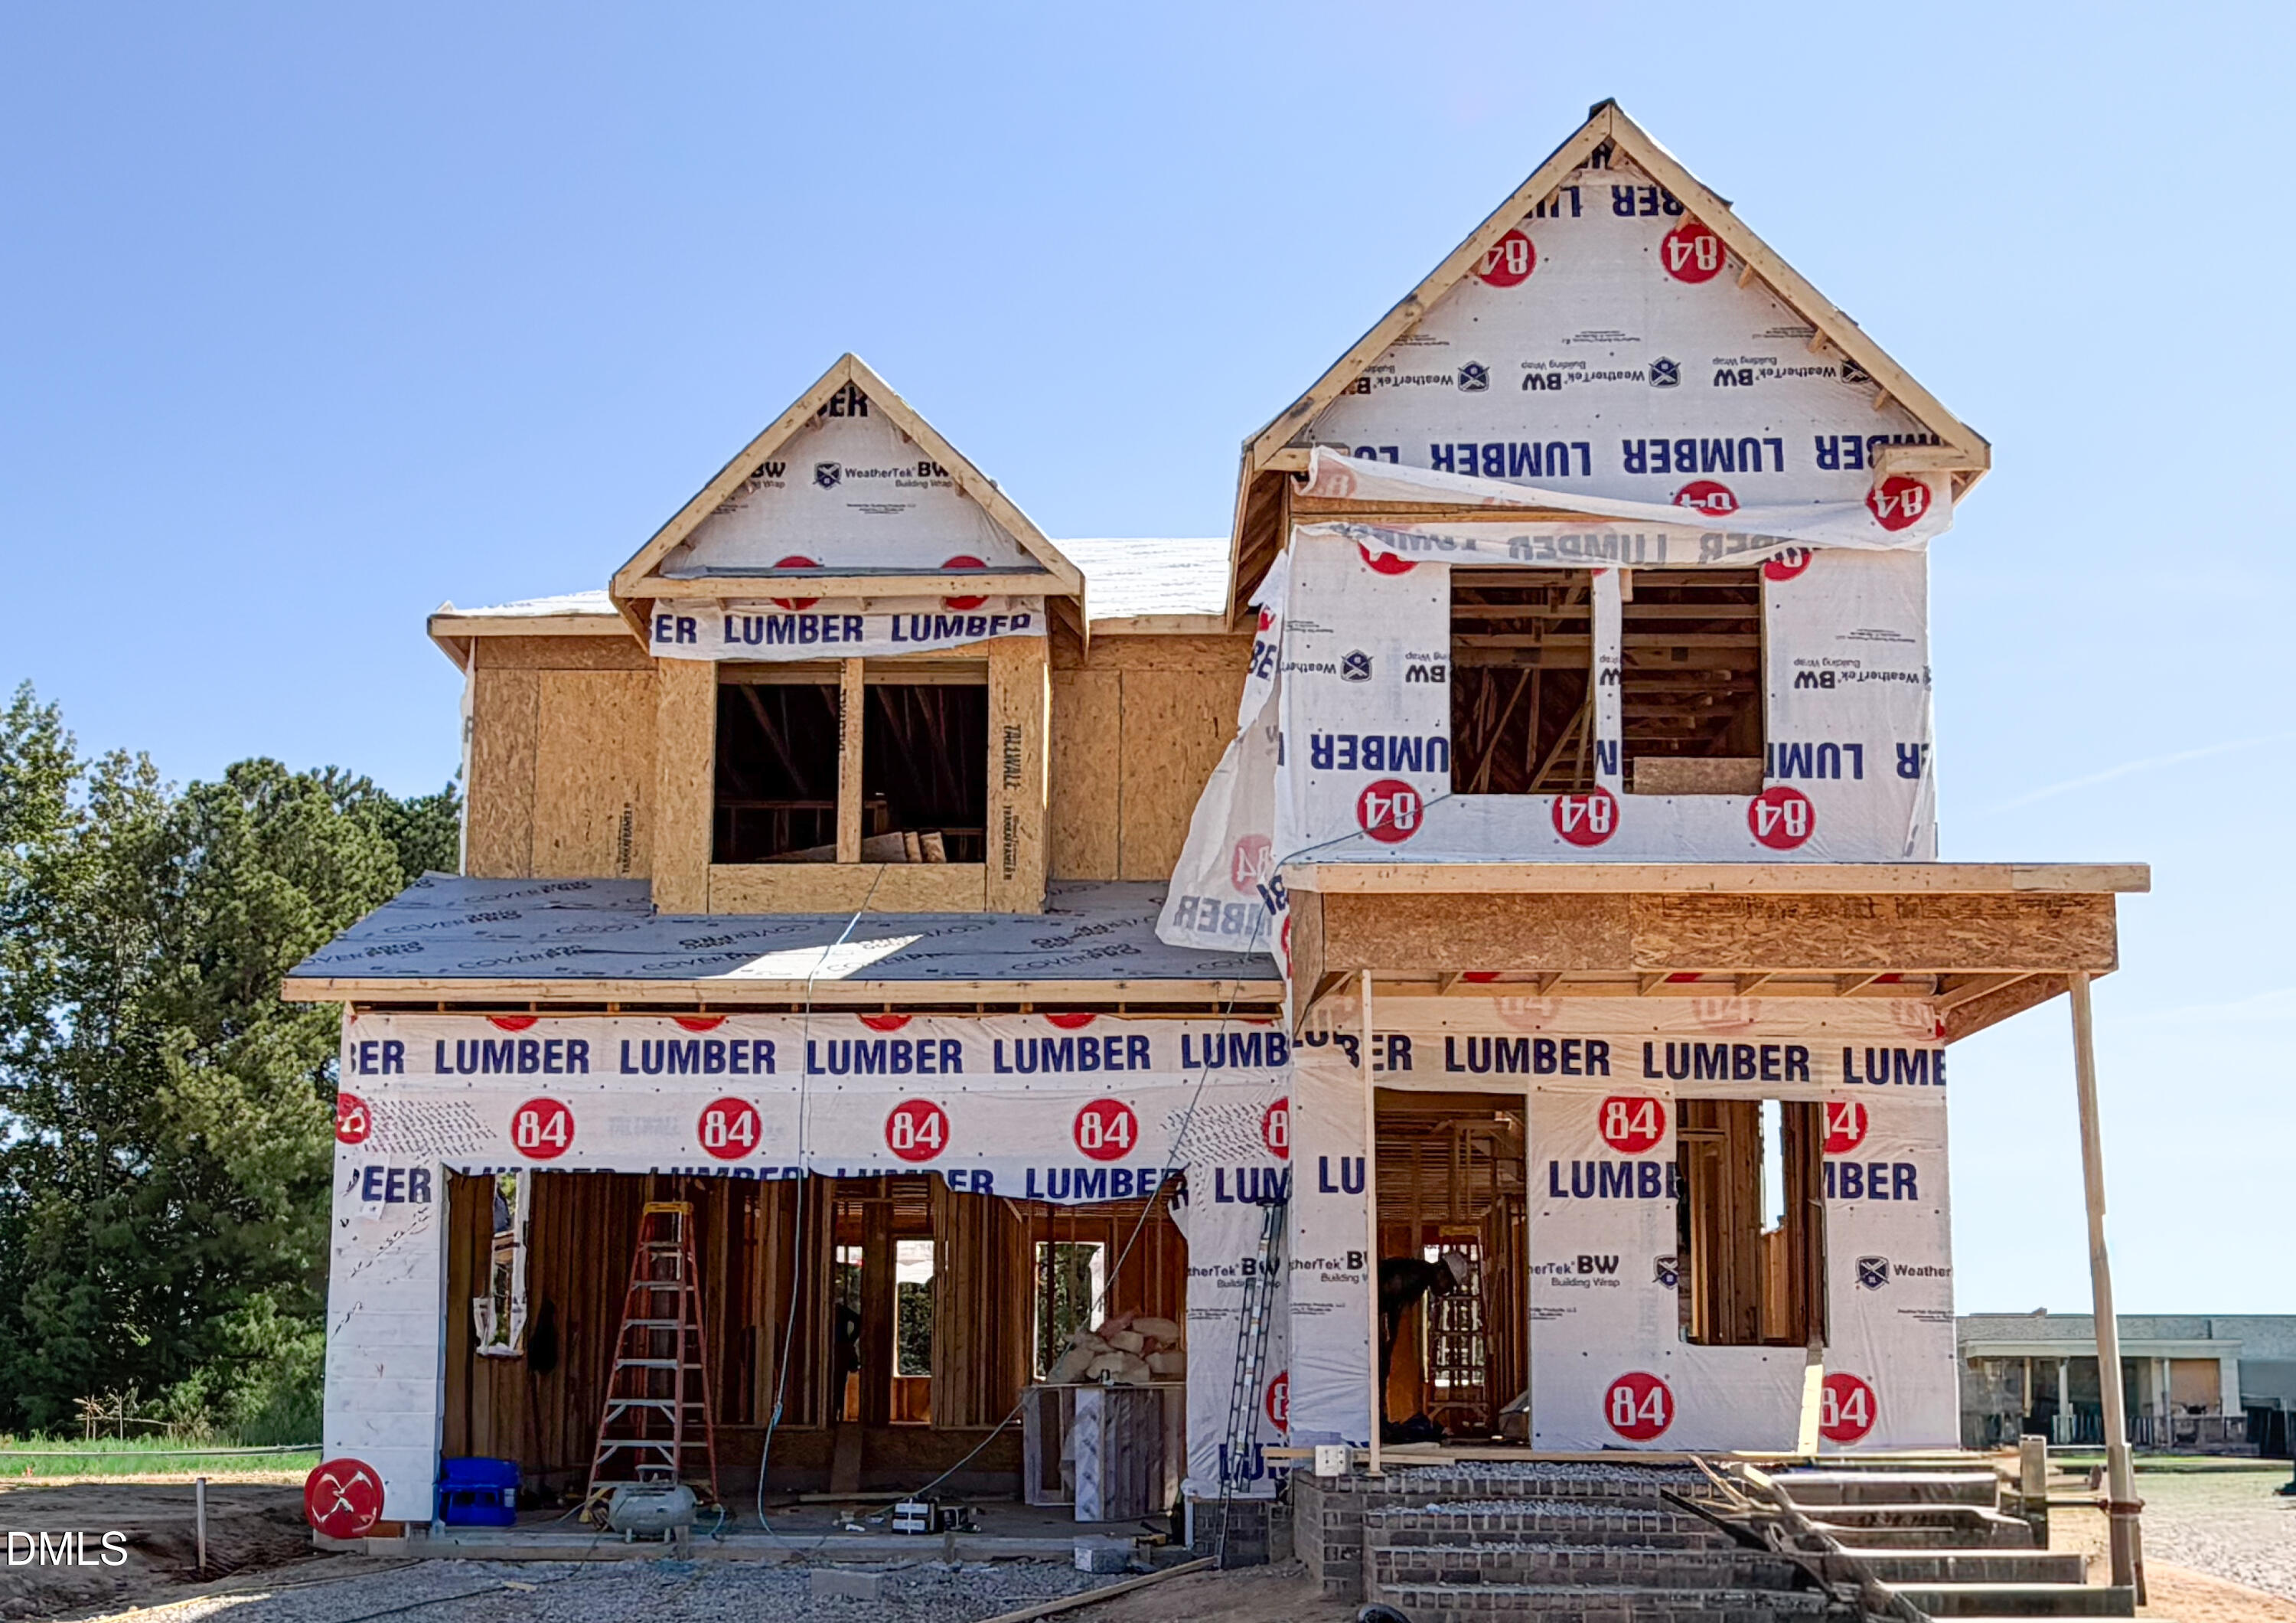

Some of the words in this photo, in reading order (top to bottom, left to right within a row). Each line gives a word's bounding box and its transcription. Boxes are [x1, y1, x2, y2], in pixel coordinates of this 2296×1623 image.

[1479, 239, 1528, 276] 84
[1668, 235, 1718, 272] 84
[1521, 372, 1562, 391] BW
[1713, 367, 1754, 387] BW
[844, 467, 916, 479] WeatherTek
[1430, 441, 1591, 478] LUMBER
[1622, 437, 1784, 474] LUMBER
[1872, 485, 1924, 519] 84
[649, 614, 697, 645] ER
[723, 613, 864, 645] LUMBER
[1404, 664, 1446, 684] BW
[1792, 671, 1836, 690] BW
[1767, 741, 1864, 780] LUM
[1364, 790, 1415, 831] 84
[1559, 795, 1612, 834] 84
[1754, 798, 1808, 837] 84
[435, 1039, 590, 1075] LUMBER
[619, 1039, 776, 1075] LUMBER
[807, 1038, 964, 1075] LUMBER
[993, 1034, 1152, 1074] LUMBER
[1444, 1035, 1611, 1076] LUMBER
[1642, 1040, 1811, 1083] LUMBER
[517, 1110, 567, 1148] 84
[703, 1109, 755, 1148] 84
[892, 1111, 942, 1150] 84
[1081, 1111, 1131, 1149] 84
[1606, 1100, 1658, 1141] 84
[1577, 1254, 1619, 1275] BW
[1611, 1386, 1667, 1428] 84
